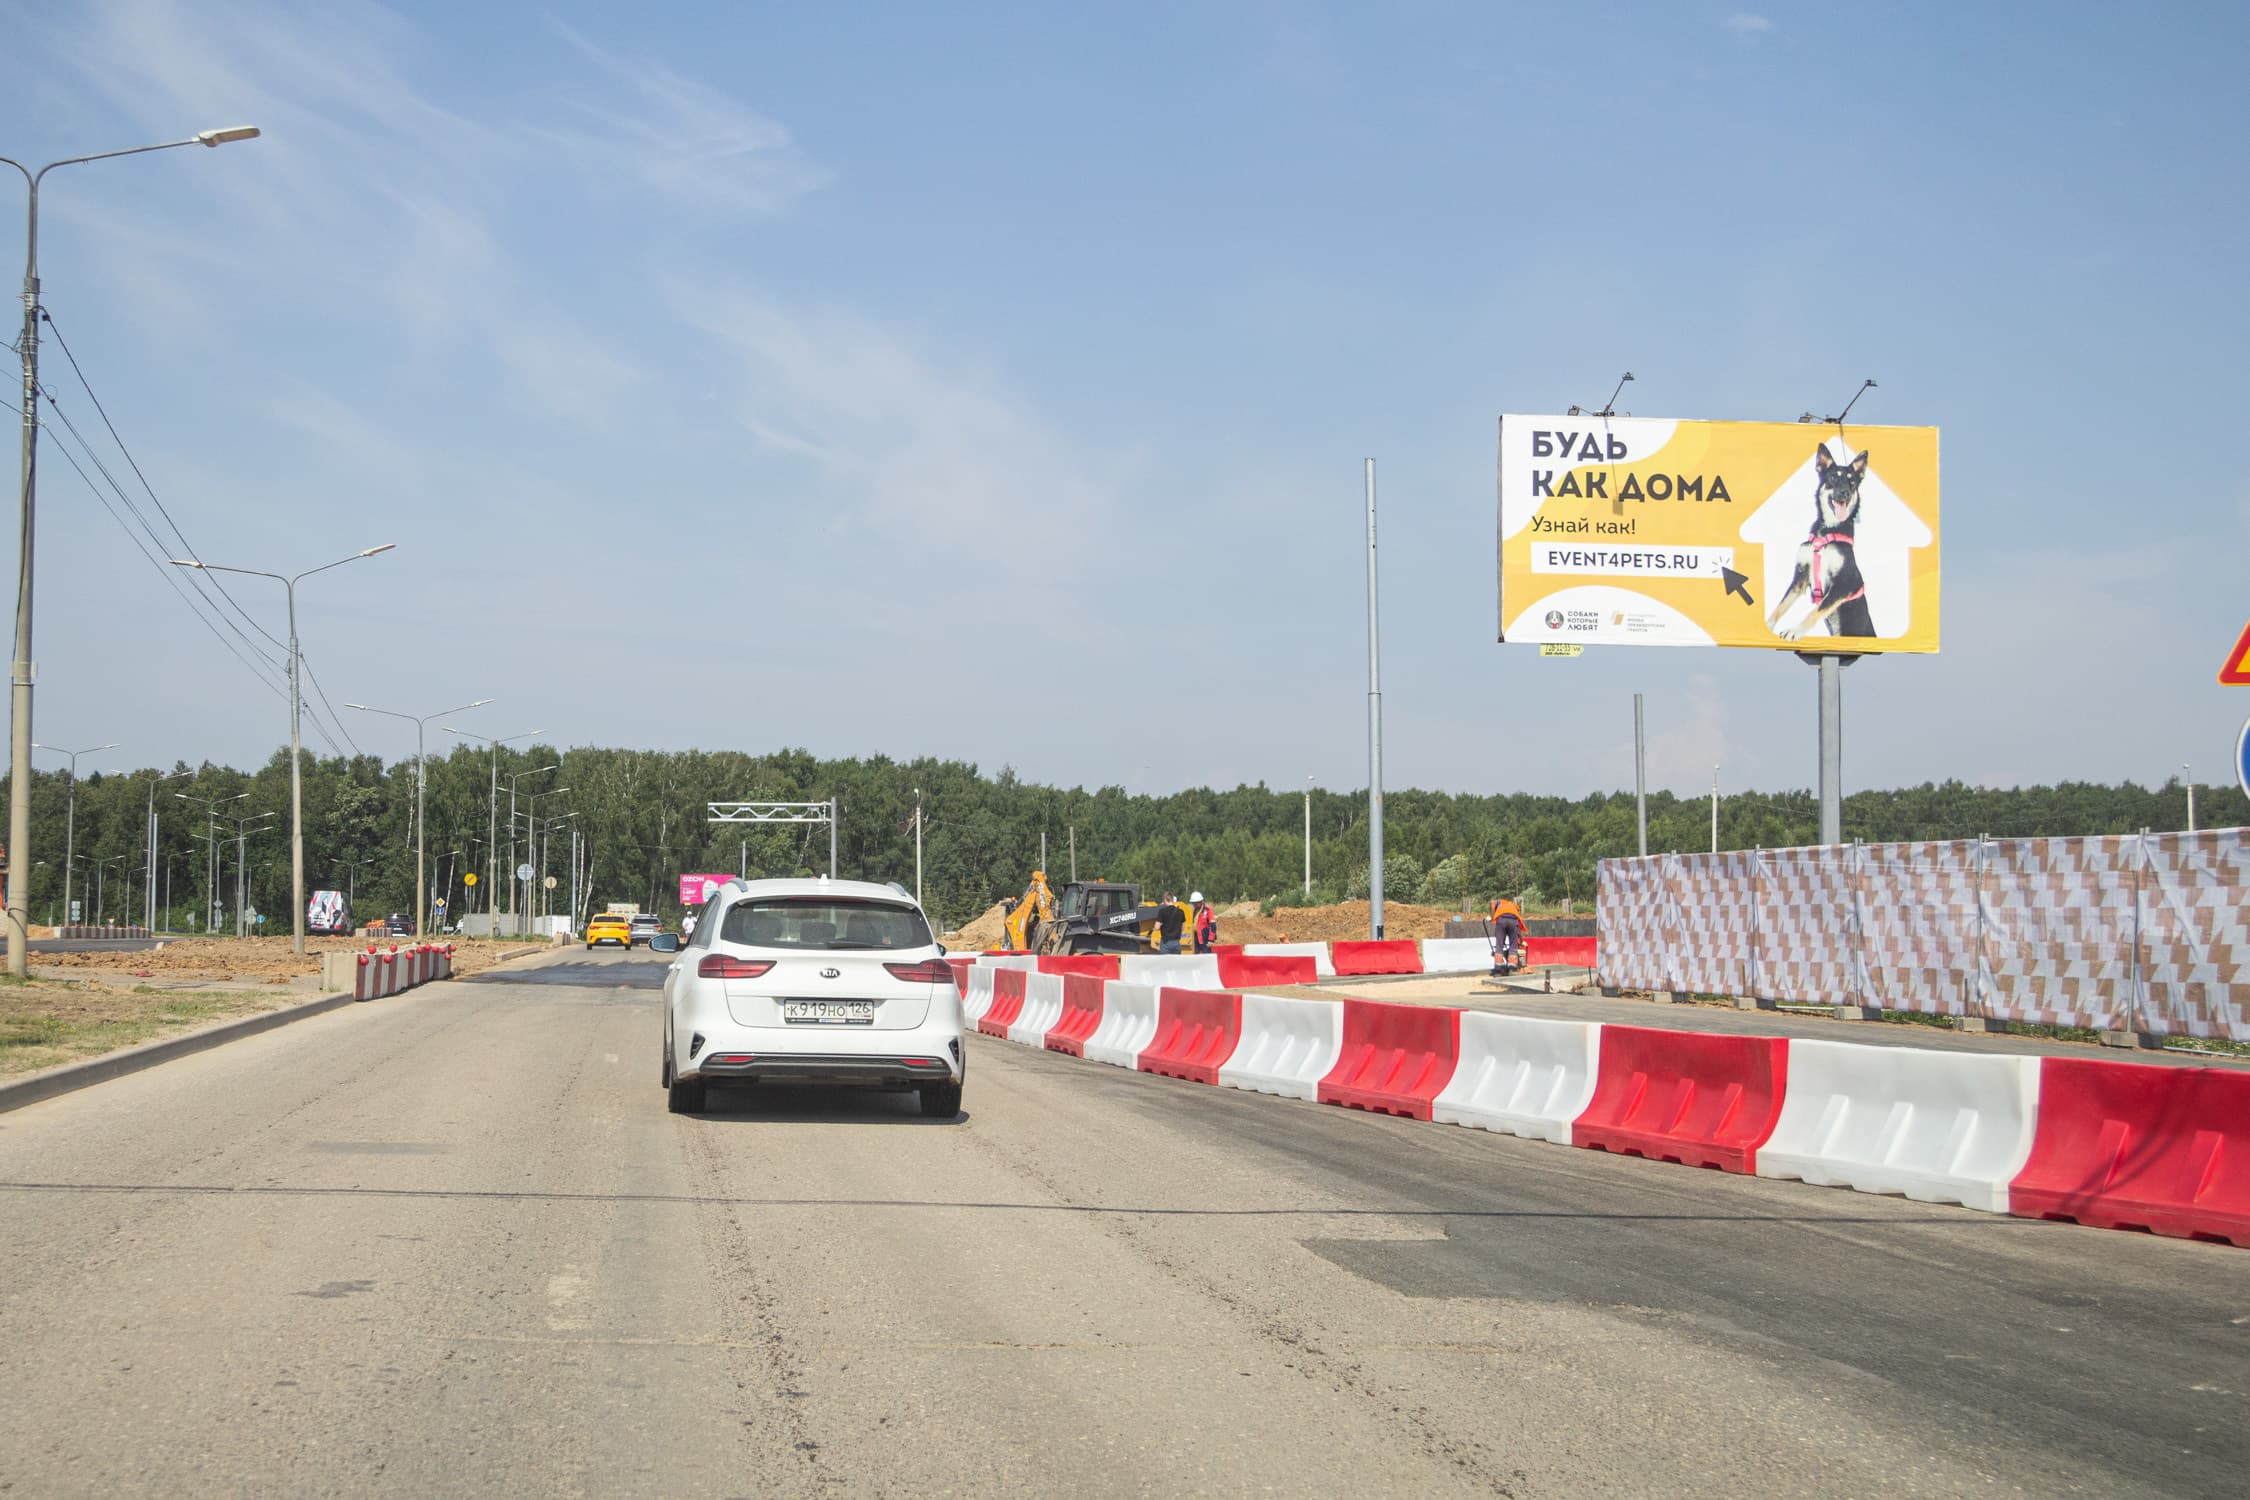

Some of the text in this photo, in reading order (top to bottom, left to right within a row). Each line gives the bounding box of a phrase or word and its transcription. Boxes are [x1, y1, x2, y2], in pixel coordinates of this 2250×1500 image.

[1532, 431, 1627, 462] БУДЬ
[1532, 470, 1731, 502] КАК ДОМА
[1532, 516, 1636, 535] Узнай как!
[1548, 551, 1699, 570] EVENT4PETS.RU
[1567, 610, 1599, 618] СОБАКИ
